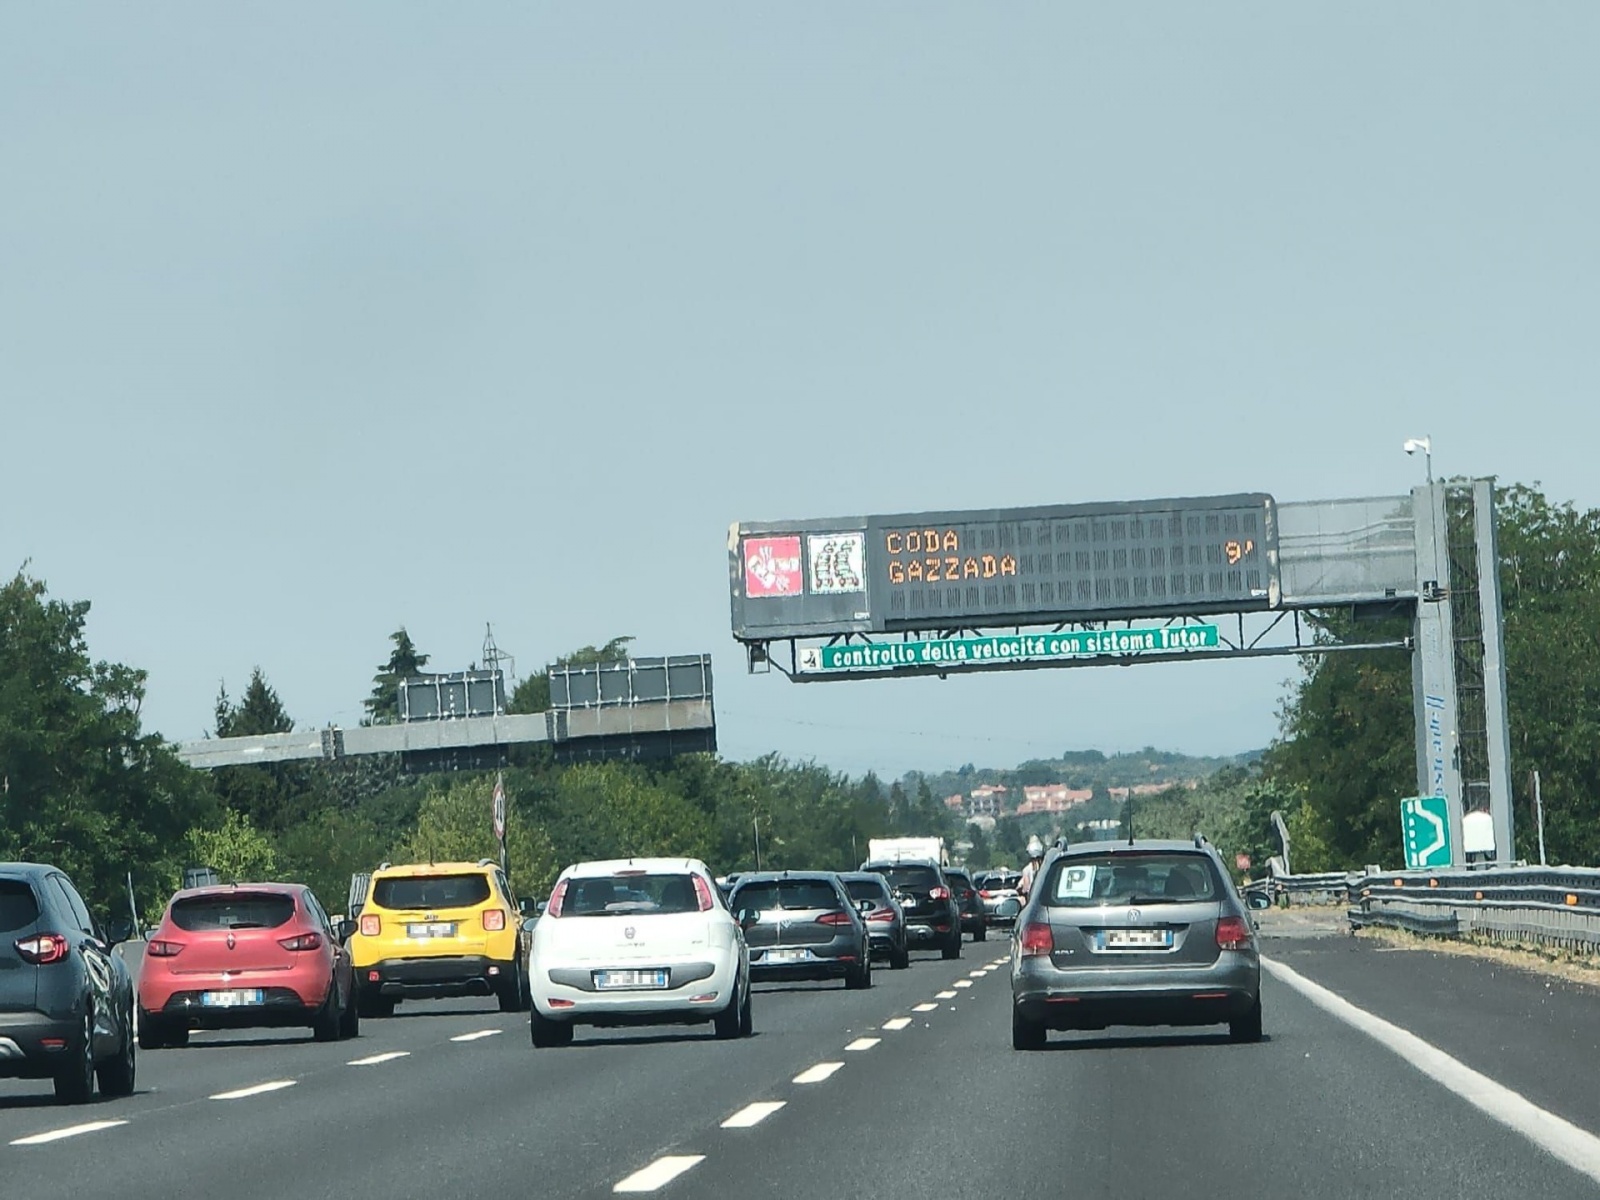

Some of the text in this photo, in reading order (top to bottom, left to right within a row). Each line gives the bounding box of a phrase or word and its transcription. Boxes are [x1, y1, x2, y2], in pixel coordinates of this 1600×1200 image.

[887, 530, 958, 554] CODA
[889, 555, 1017, 584] GAZZADA
[833, 644, 915, 666] controllo
[922, 641, 967, 662] della
[1050, 639, 1079, 653] con
[1087, 632, 1154, 651] sistema
[1160, 629, 1207, 648] Tutor
